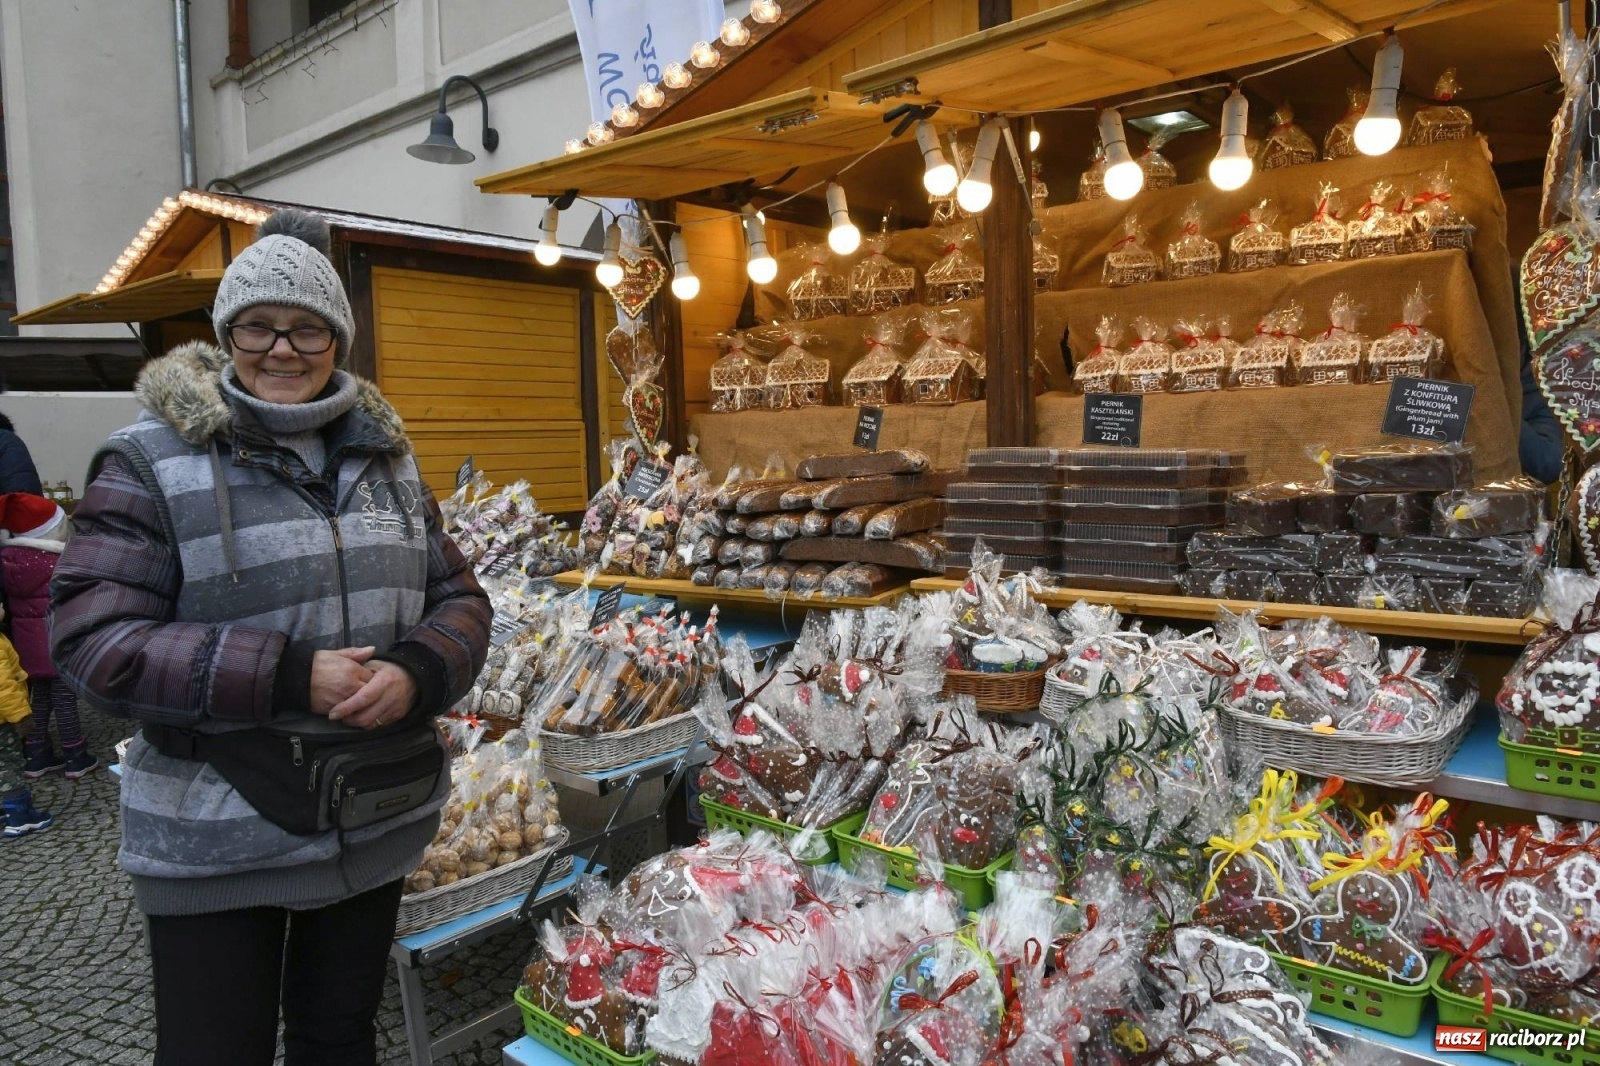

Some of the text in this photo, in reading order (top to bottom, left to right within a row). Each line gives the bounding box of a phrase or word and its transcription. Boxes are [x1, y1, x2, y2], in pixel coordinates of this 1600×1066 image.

[1417, 382, 1450, 393] PIERNIK
[1403, 388, 1459, 405] Z KONFITURĄ
[1101, 400, 1124, 408] PIERNIK
[1406, 397, 1452, 413] ŚLIWKOWĄ
[1091, 406, 1134, 415] KASZTELAŃSKI
[1395, 405, 1460, 420] (Gingerbread with
[1407, 414, 1443, 425] plum jam)
[1411, 423, 1435, 436] 13zł
[1101, 431, 1119, 441] 22zł
